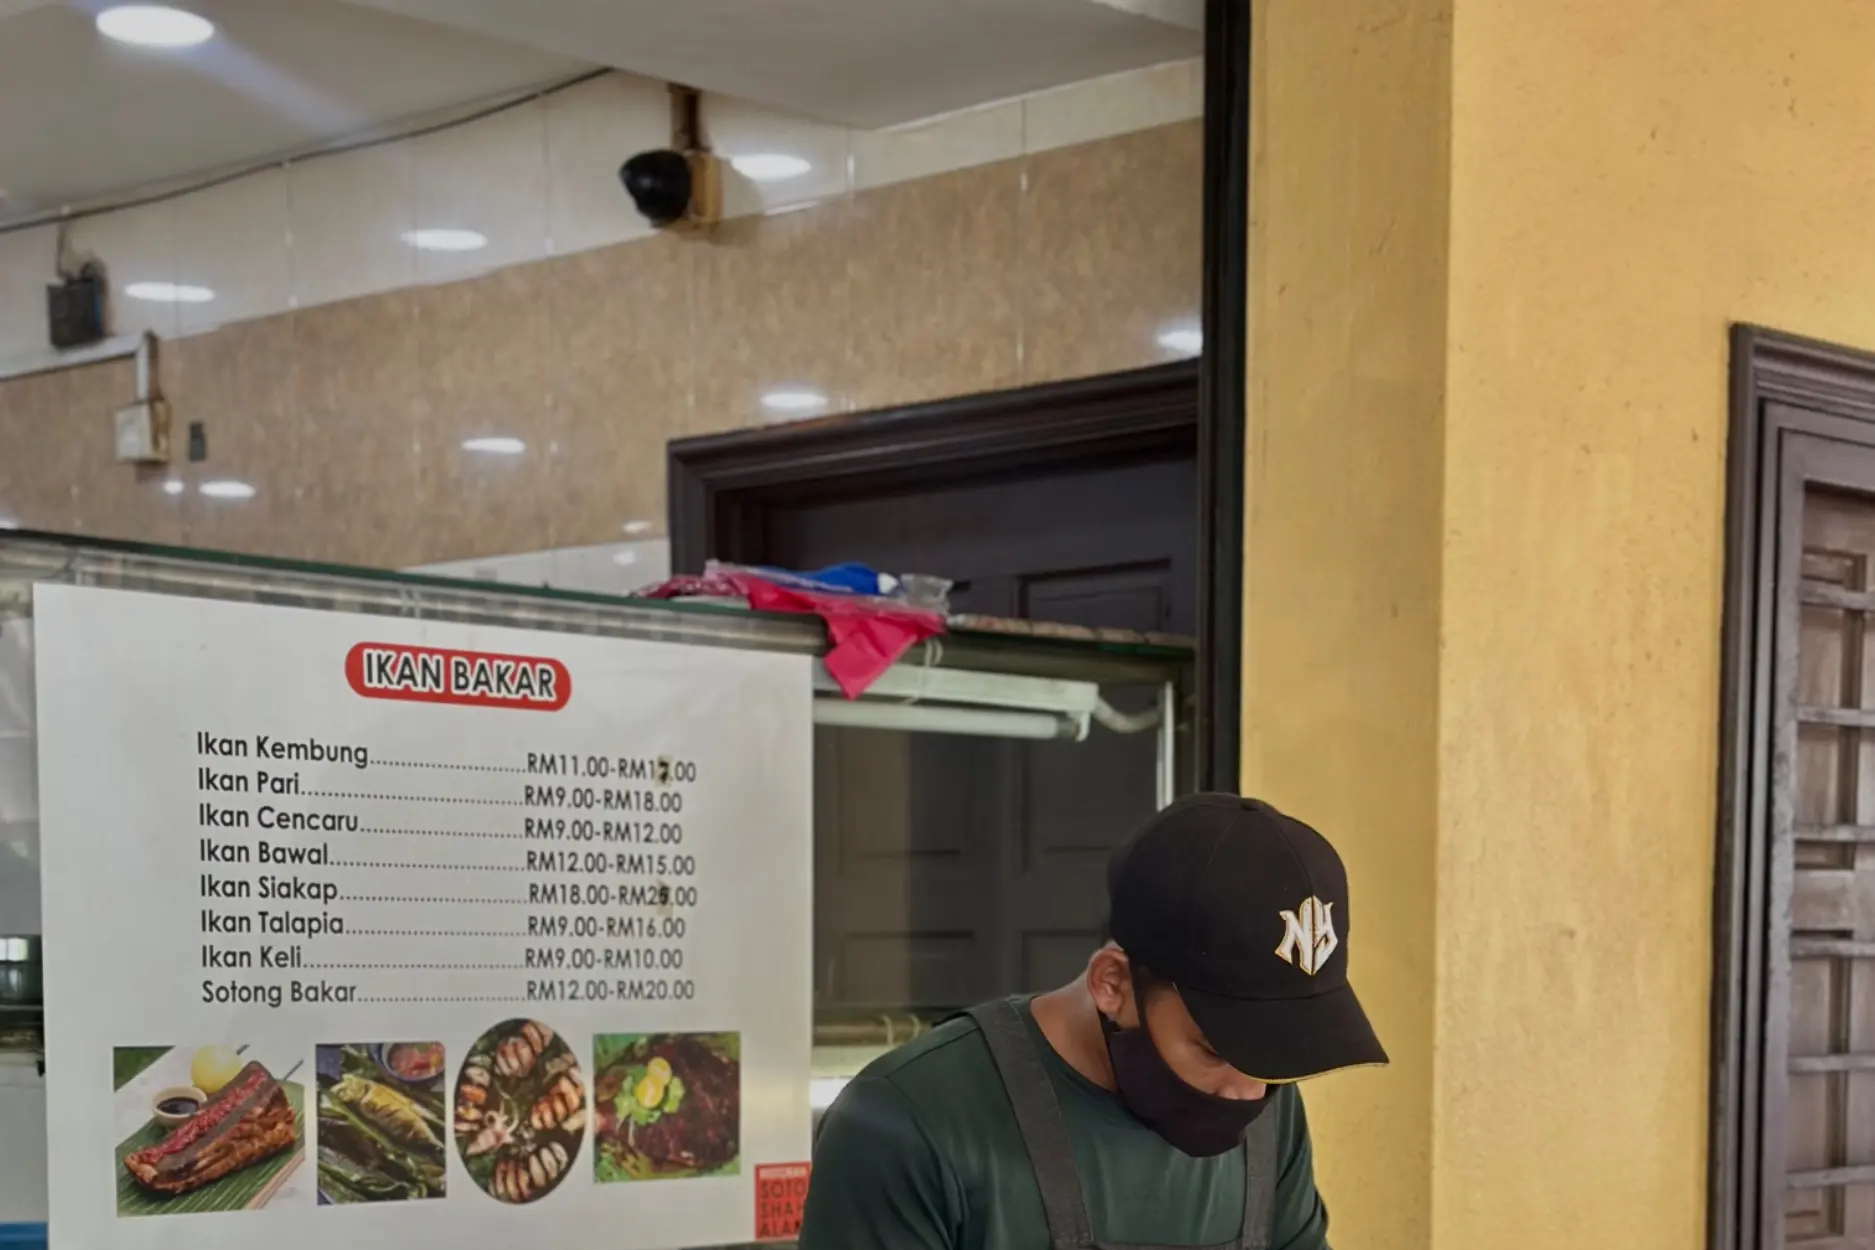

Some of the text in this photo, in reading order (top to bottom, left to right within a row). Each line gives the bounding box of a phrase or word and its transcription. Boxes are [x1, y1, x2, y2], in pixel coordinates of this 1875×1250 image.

[364, 651, 556, 700] IKAN BAKAR
[197, 731, 248, 757] Ikan
[256, 735, 369, 768] Kembung
[198, 767, 683, 813] Ikan Pari RM9.00-RM18.00
[199, 803, 683, 845] Ikan Cencaru RM9.00-RM12.00
[200, 838, 696, 876] Ikan Bawal RM12.00-RM15.00
[200, 874, 250, 898] Ikan
[258, 875, 338, 905] Siakap
[201, 909, 686, 940] Ikan Talapia RM9.00-RM16.00
[202, 945, 684, 970] Ikan Keli RM9.00-RM10.00
[202, 979, 695, 1008] Sotong Bakar RM12.00-RM20.00
